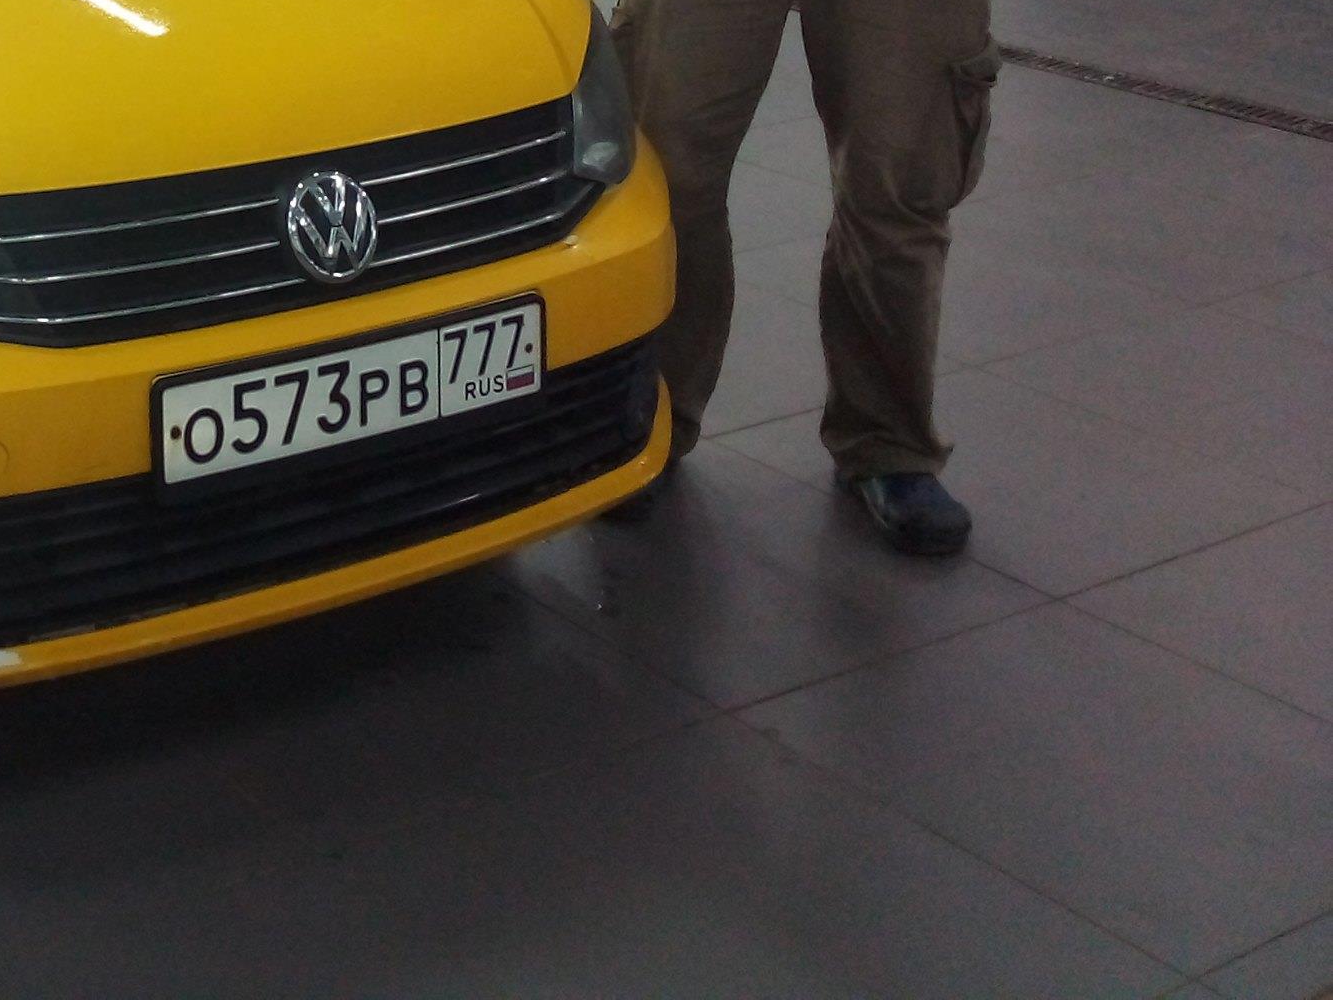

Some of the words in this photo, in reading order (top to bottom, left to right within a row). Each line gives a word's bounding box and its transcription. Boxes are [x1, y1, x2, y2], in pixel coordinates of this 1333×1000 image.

[183, 359, 430, 464] О573РВ
[443, 315, 525, 385] 777
[465, 374, 504, 400] RUS
